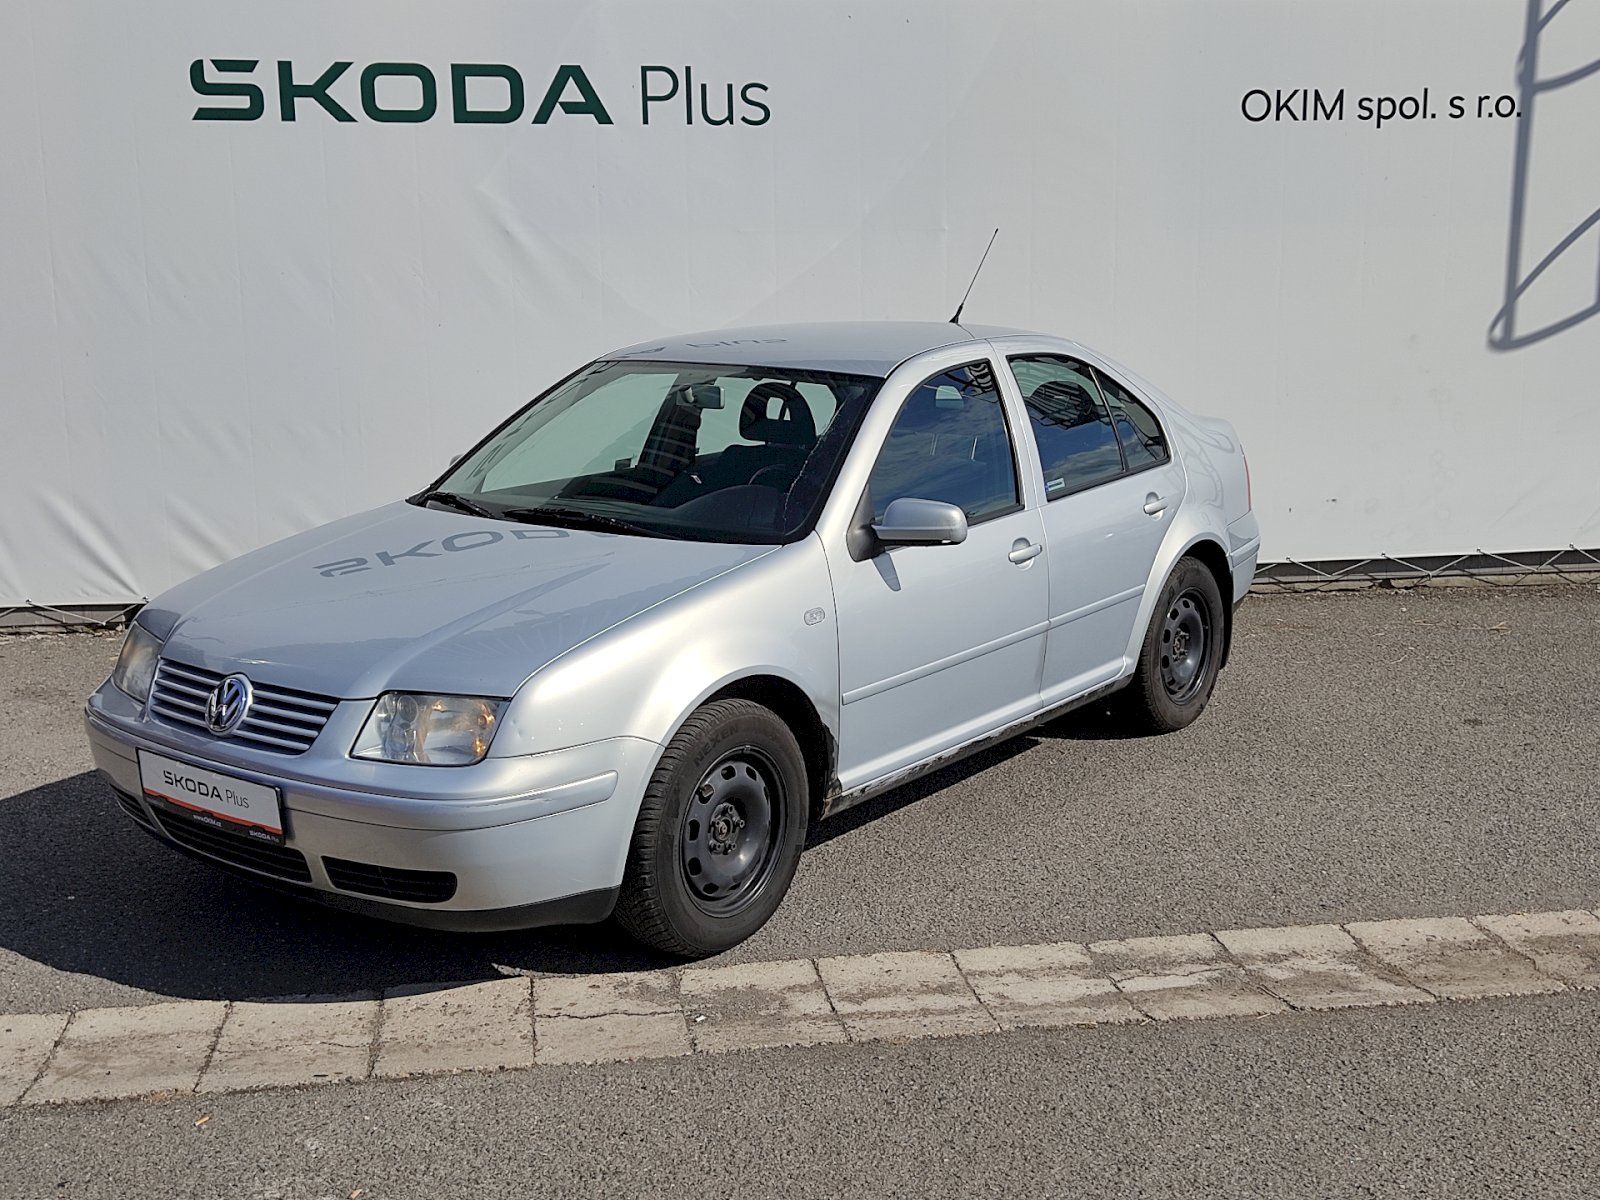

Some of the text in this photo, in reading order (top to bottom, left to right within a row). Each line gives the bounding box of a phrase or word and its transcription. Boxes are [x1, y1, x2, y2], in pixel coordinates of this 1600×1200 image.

[640, 65, 771, 127] Plus
[1241, 87, 1522, 129] OKIM spol. s r.o.
[225, 789, 250, 809] Plus
